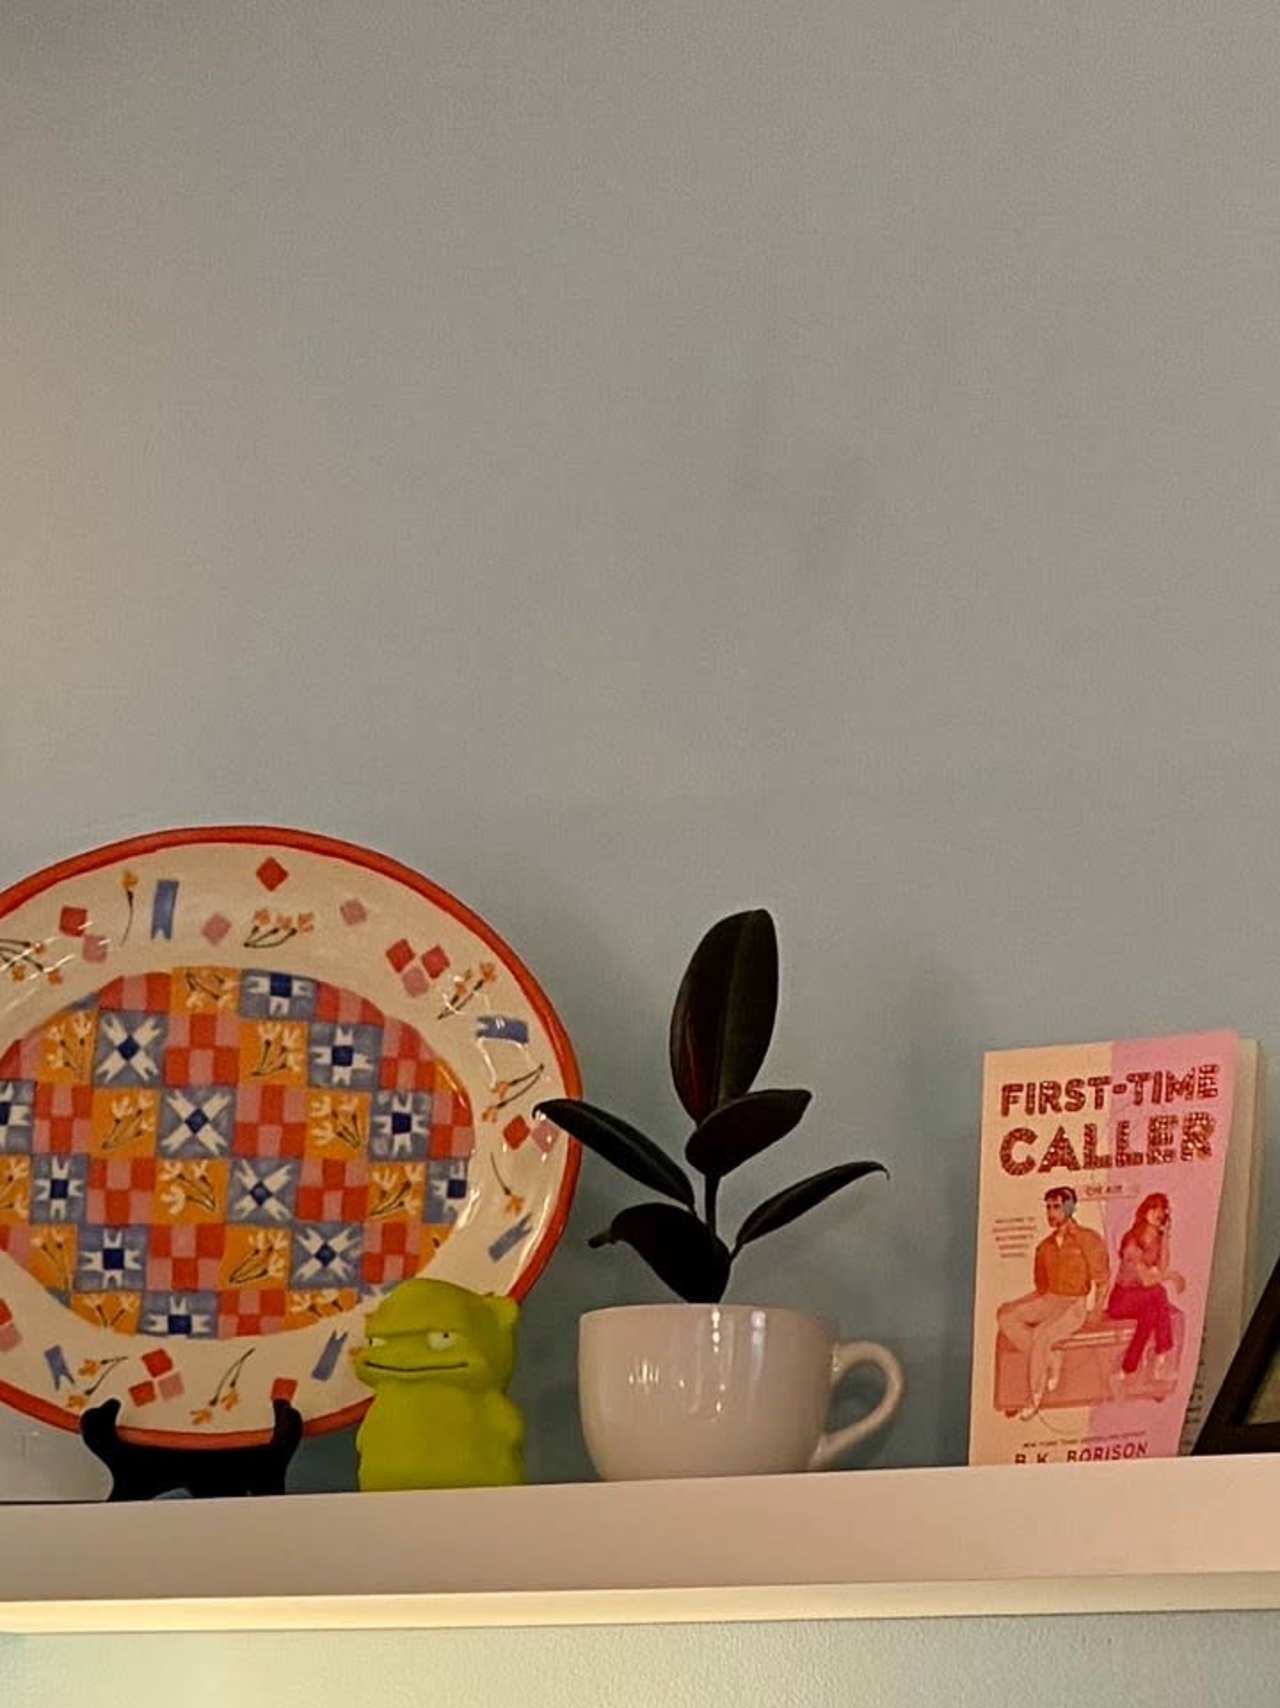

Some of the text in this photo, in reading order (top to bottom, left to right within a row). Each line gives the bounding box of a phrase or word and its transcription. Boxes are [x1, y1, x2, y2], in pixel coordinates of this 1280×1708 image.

[1000, 1064, 1219, 1117] FIRST-TIME
[999, 1111, 1217, 1176] CALLER
[1066, 1441, 1148, 1463] BORISON
